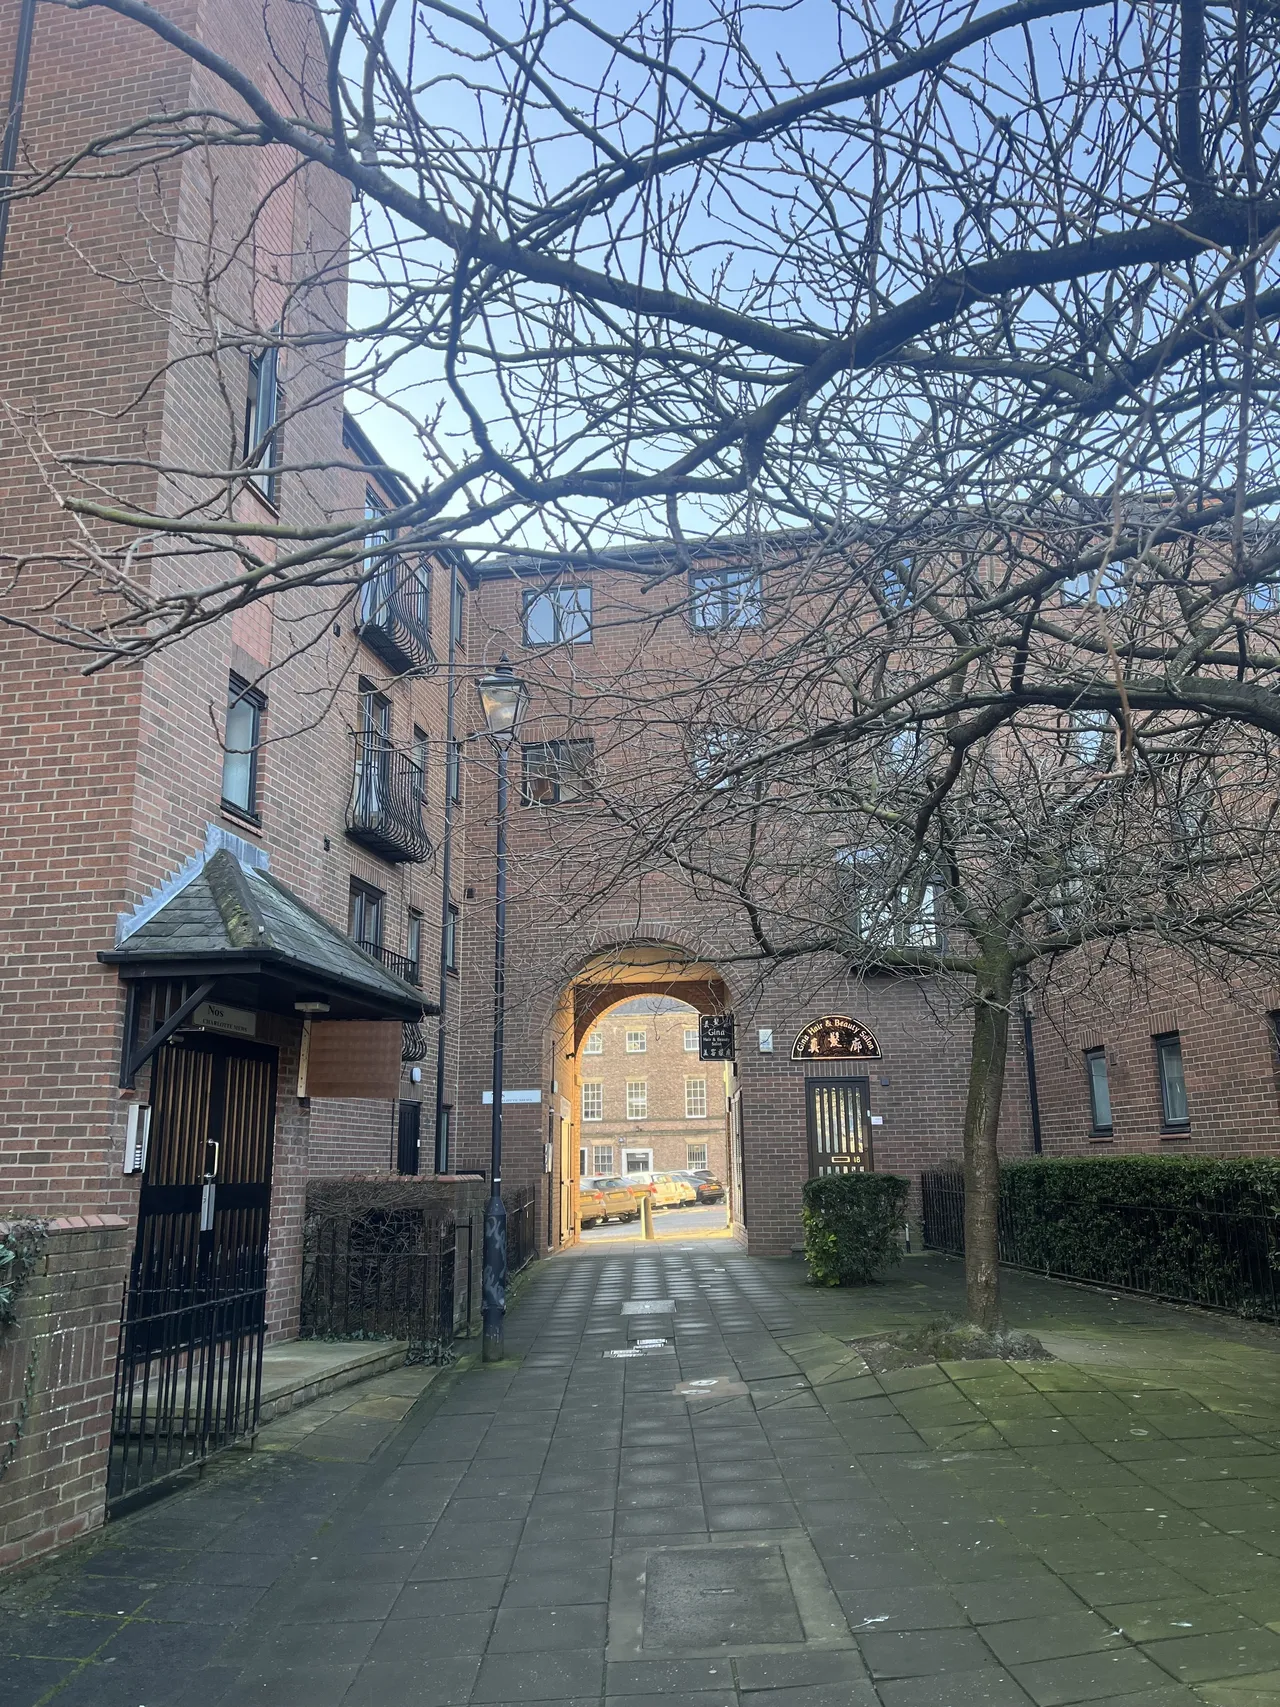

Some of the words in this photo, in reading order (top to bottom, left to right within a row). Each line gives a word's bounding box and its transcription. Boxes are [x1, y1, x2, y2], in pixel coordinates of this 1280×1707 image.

[207, 1005, 224, 1017] Nos
[708, 1028, 725, 1036] Gina
[796, 1035, 809, 1051] Gina
[807, 1023, 823, 1036] Hair
[825, 1019, 832, 1027] &
[834, 1019, 860, 1033] Beauty
[859, 1031, 874, 1050] Salon
